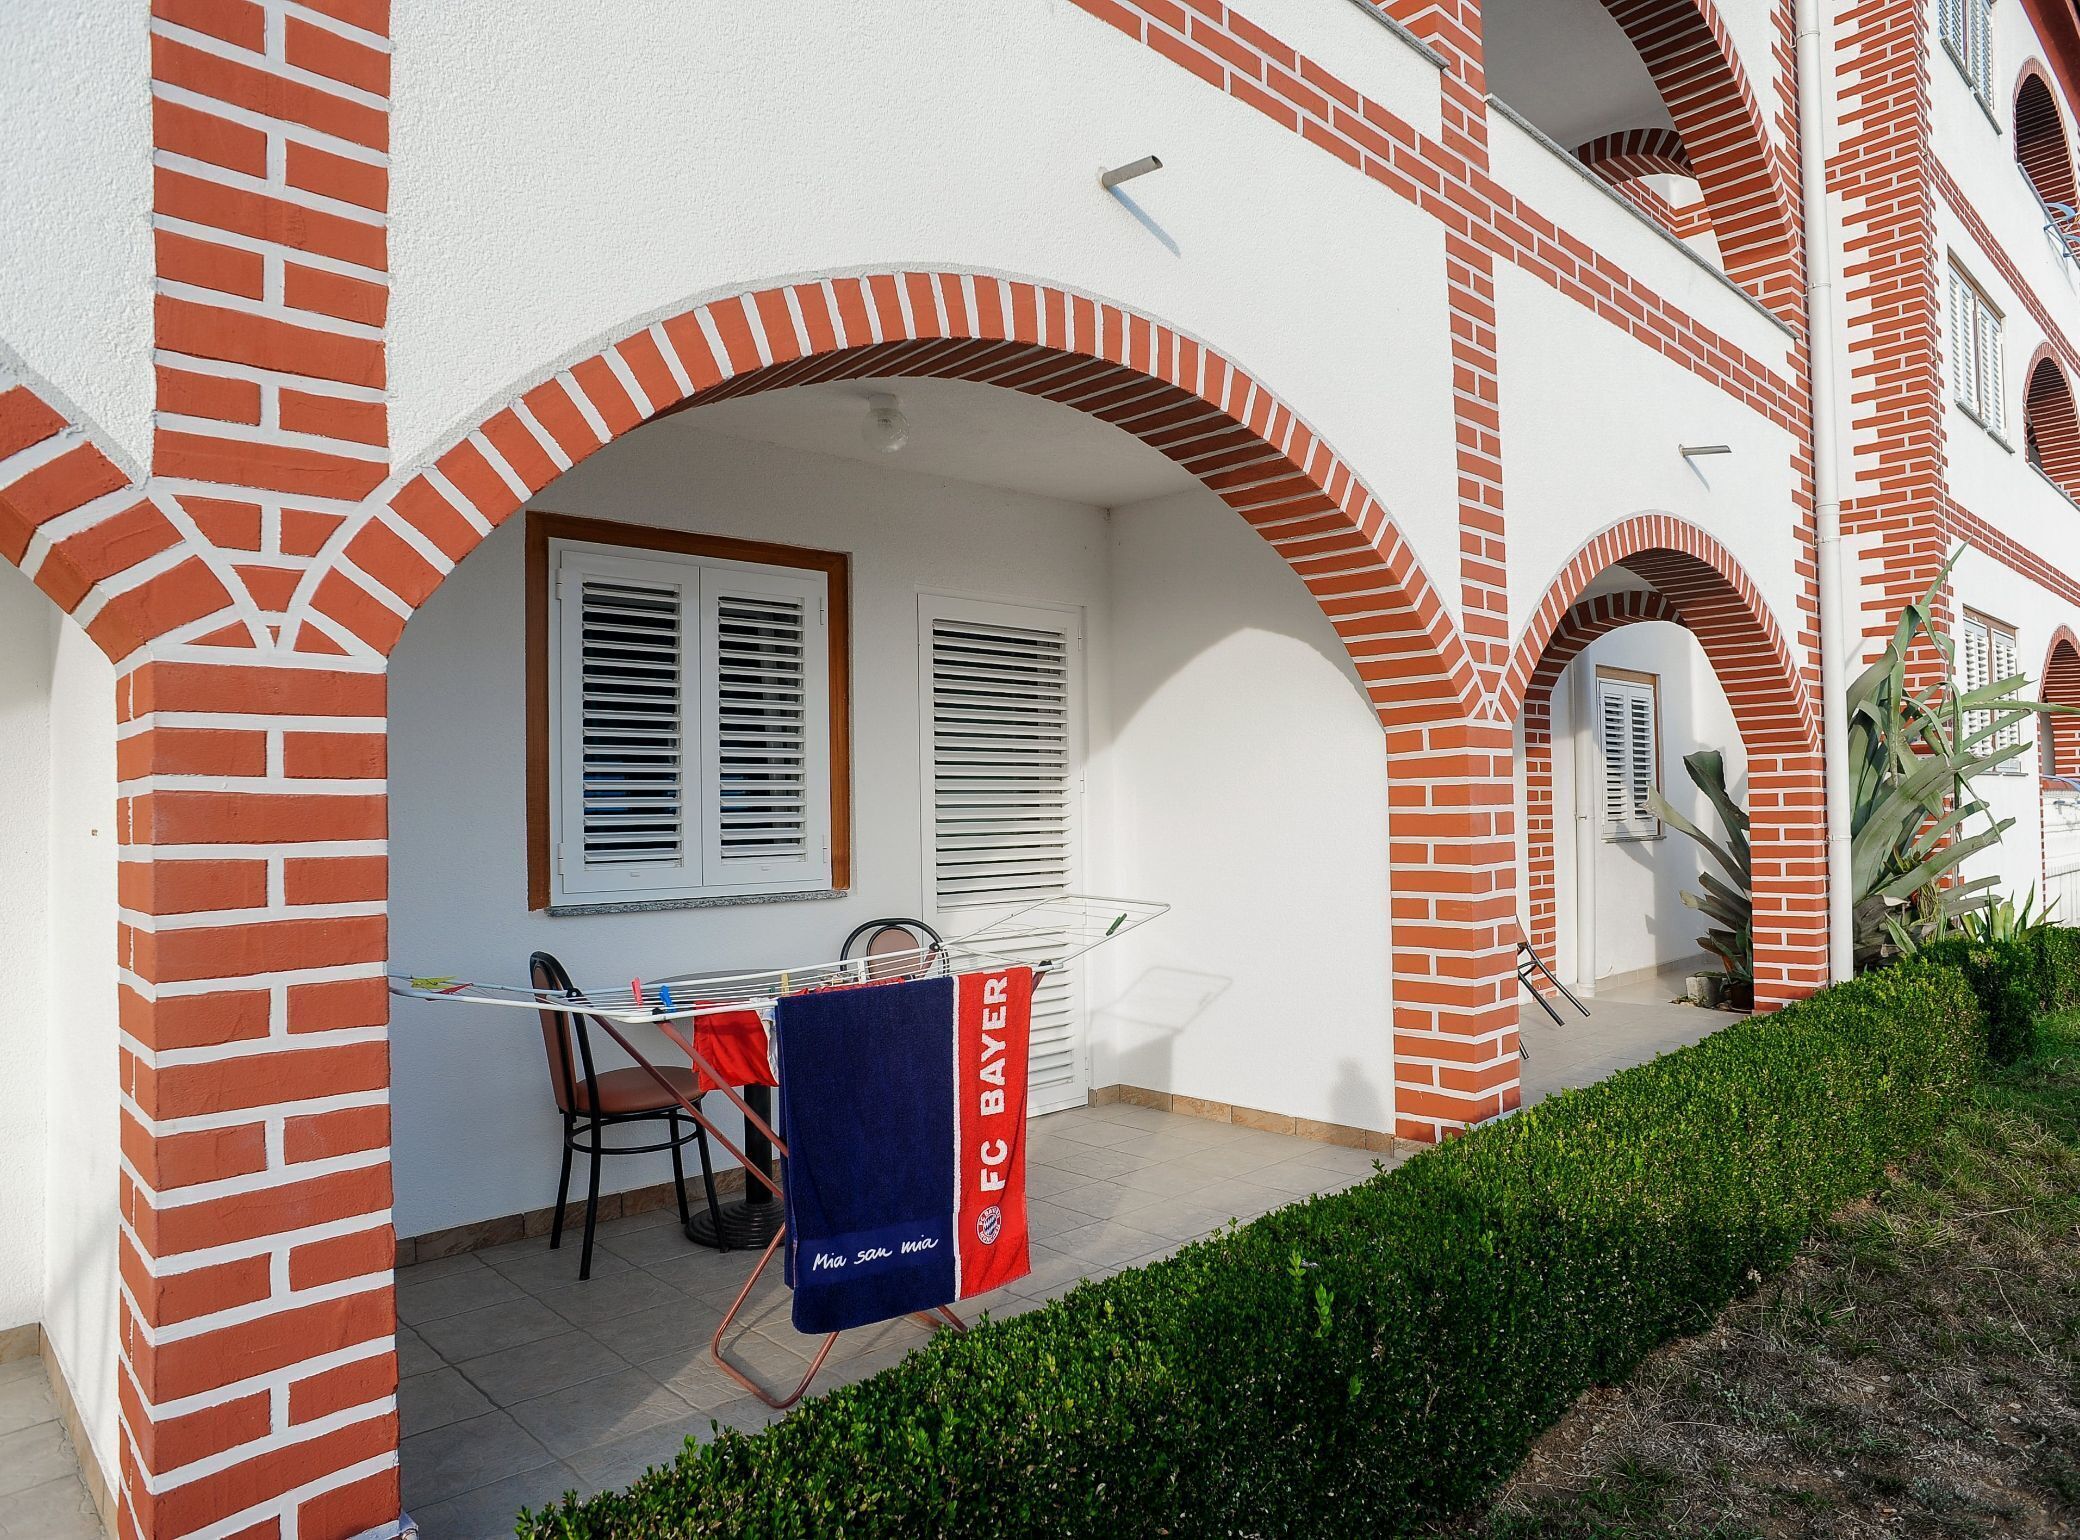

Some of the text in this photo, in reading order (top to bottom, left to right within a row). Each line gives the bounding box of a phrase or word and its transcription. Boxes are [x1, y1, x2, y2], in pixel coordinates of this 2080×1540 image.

[979, 969, 1008, 1117] BAYER
[980, 1138, 1008, 1192] FC
[812, 1234, 939, 1271] Mia san mia
